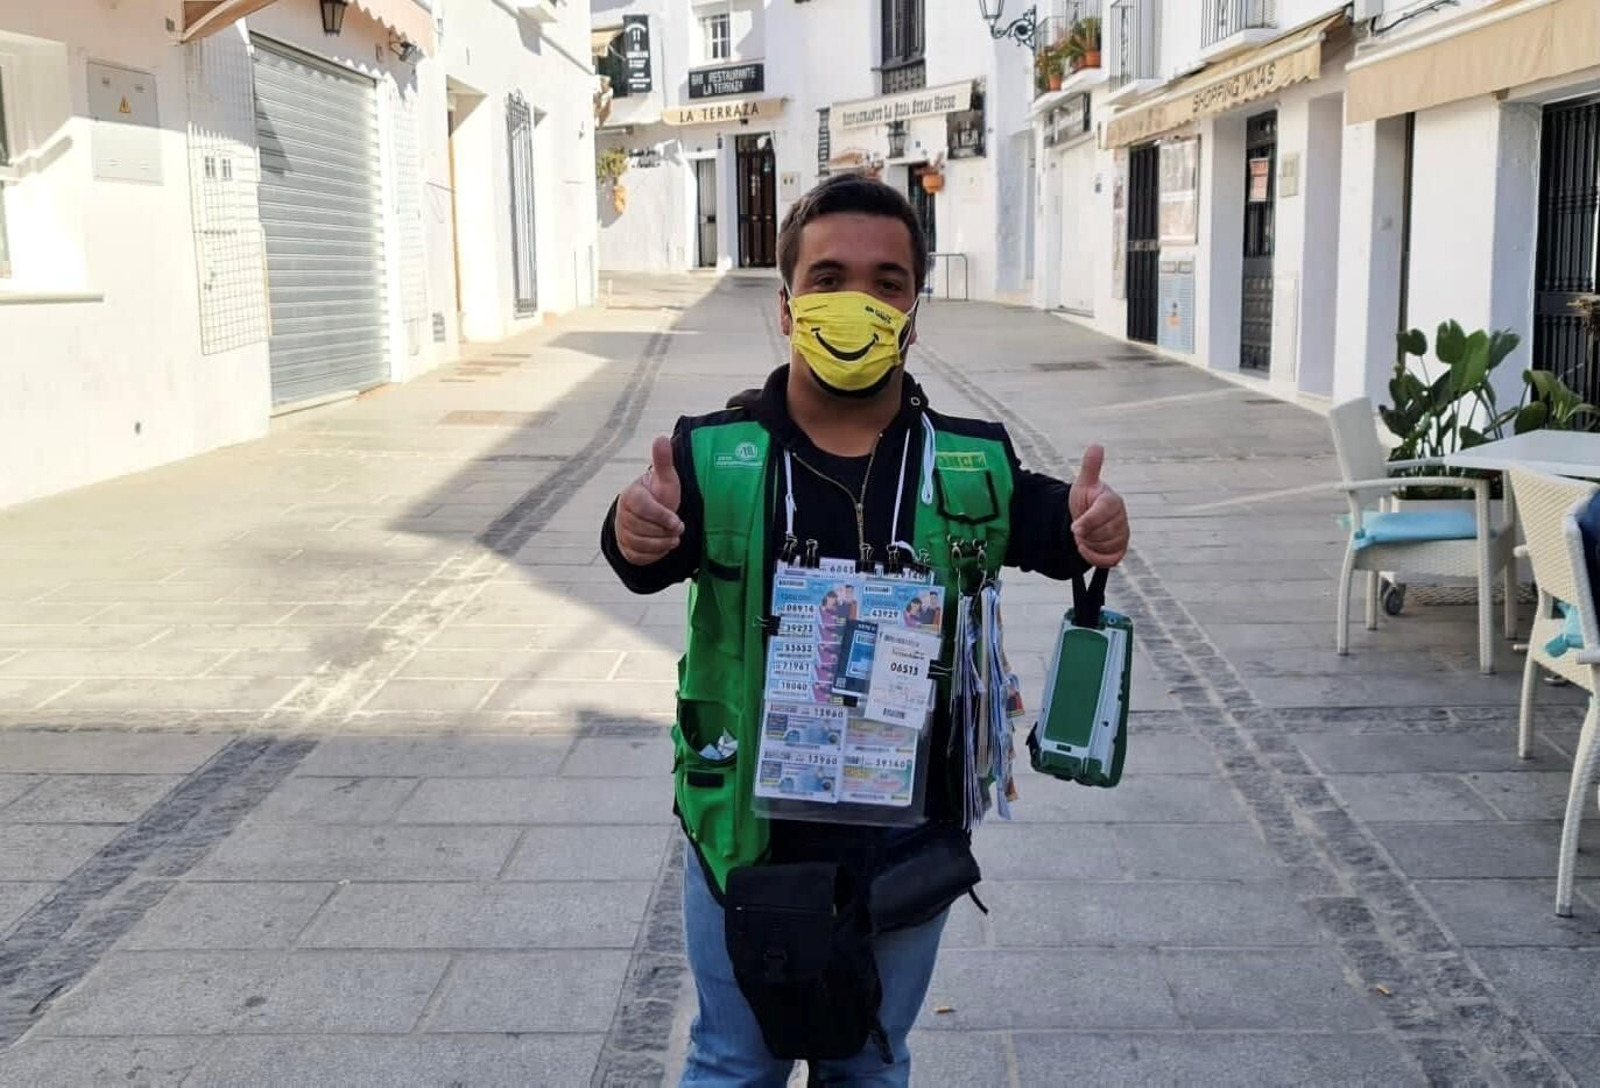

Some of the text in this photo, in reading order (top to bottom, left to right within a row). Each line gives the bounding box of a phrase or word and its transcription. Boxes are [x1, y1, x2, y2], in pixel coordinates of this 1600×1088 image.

[702, 80, 744, 95] LA TERRAZA
[1192, 76, 1240, 113] SHOPPING
[680, 102, 759, 122] LA TERRAZA
